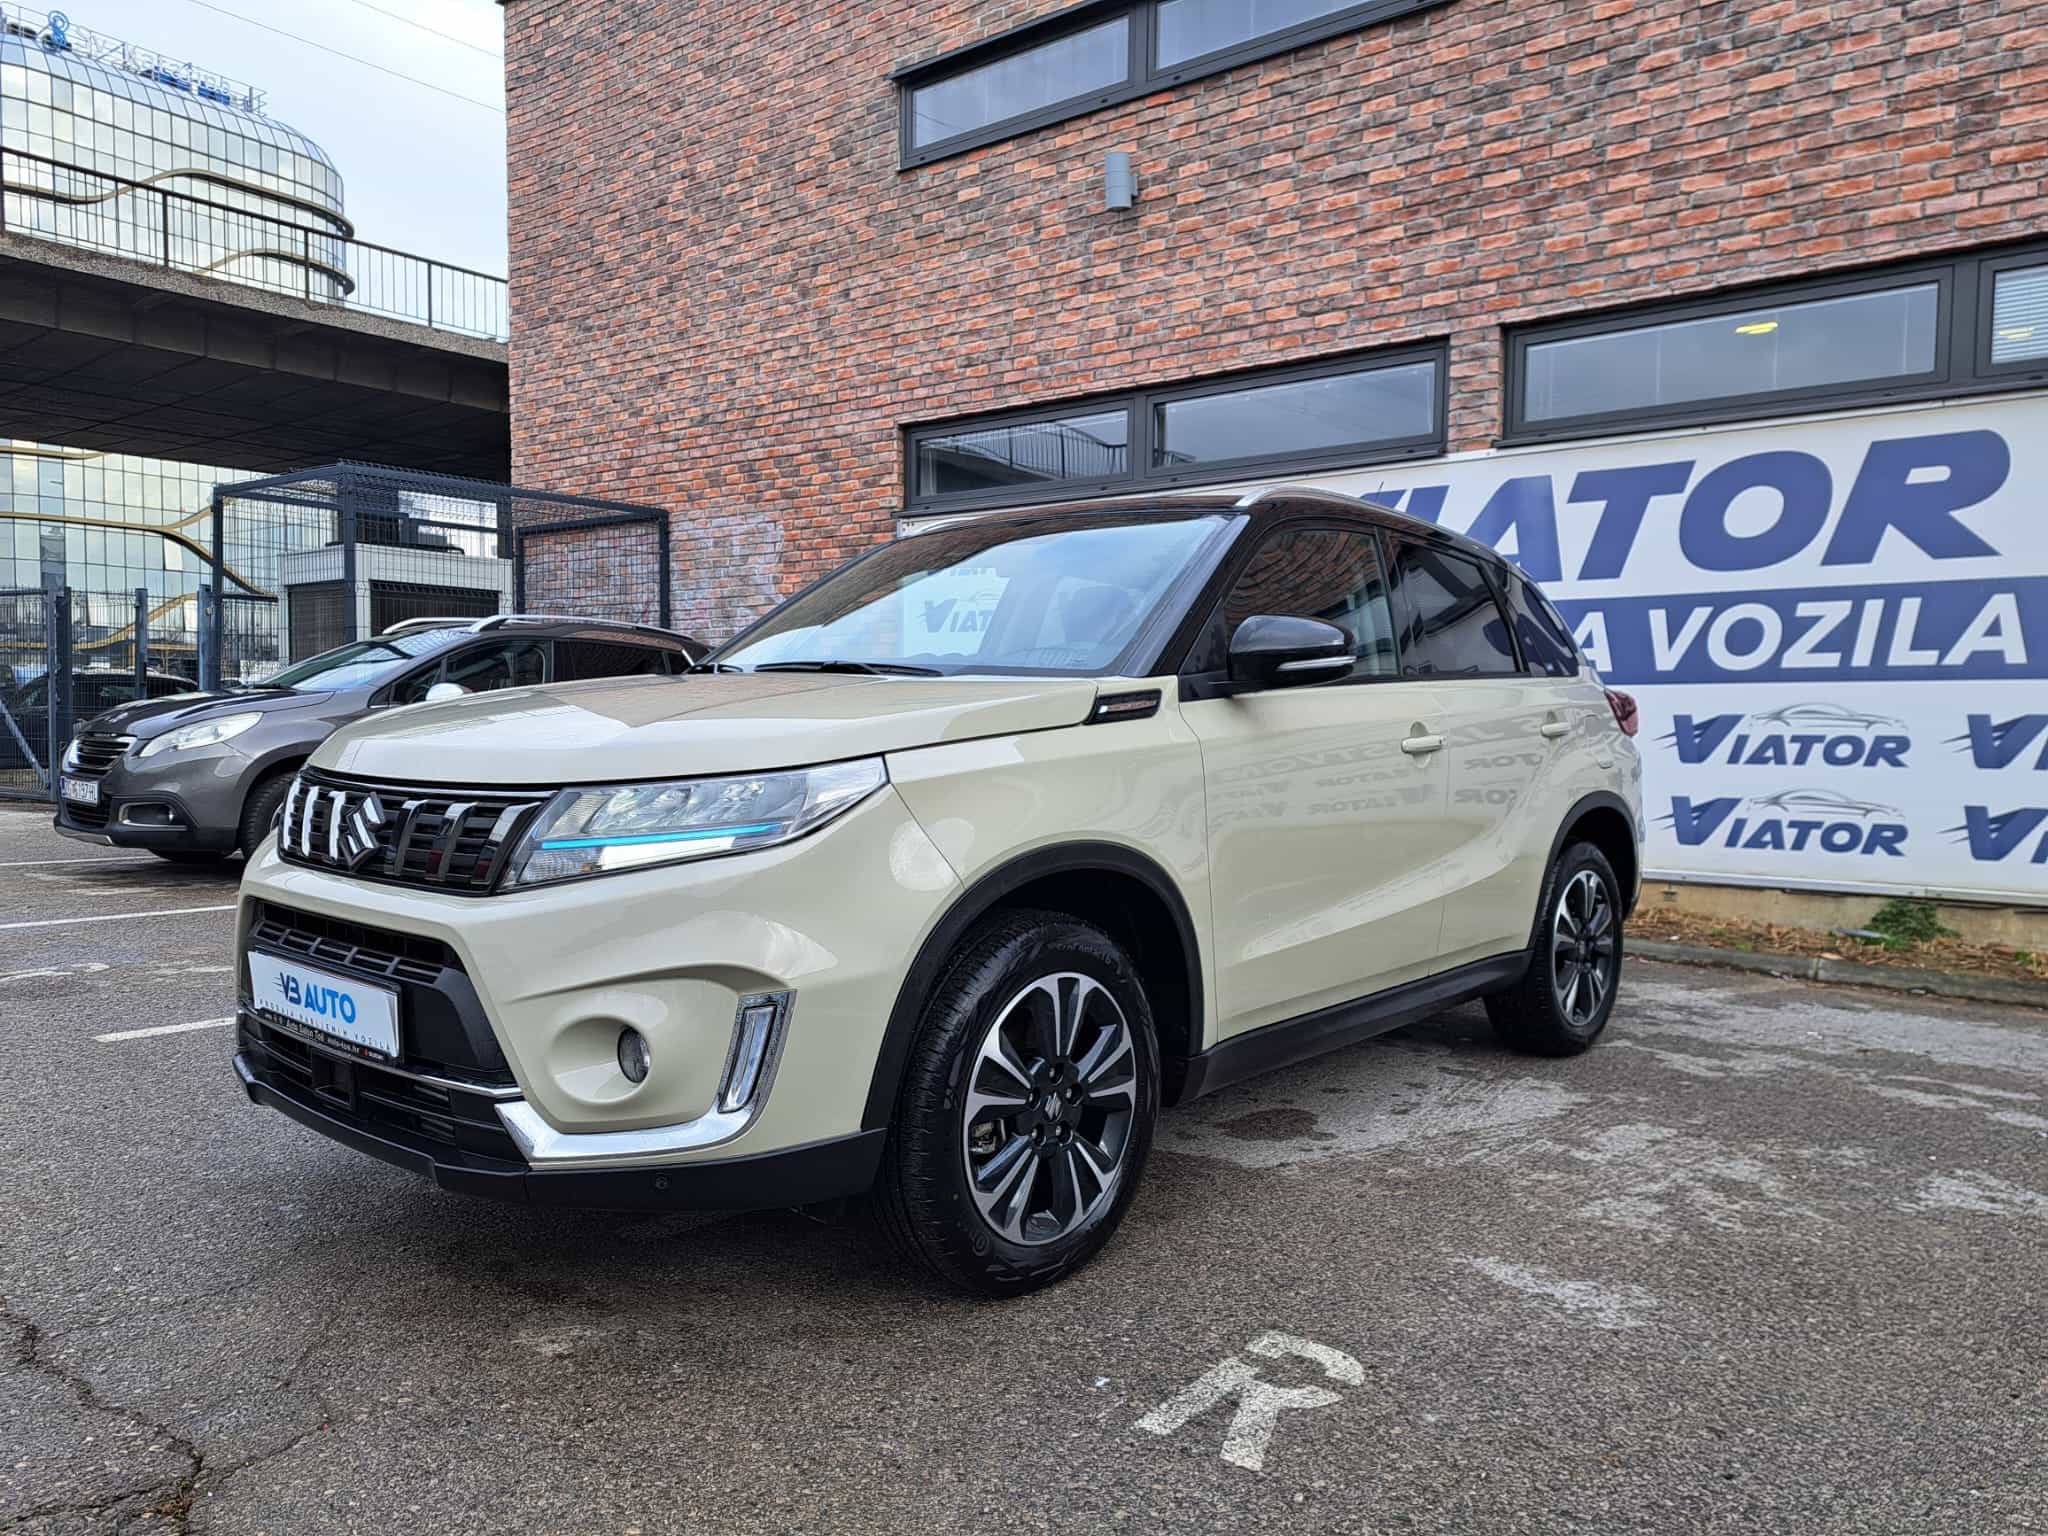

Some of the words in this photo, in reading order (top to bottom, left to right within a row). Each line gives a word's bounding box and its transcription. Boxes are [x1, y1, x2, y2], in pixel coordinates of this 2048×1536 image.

[1359, 429, 2011, 583] ATOR
[1648, 593, 2028, 672] VOZILA
[1672, 713, 1911, 768] VIATOR
[1670, 796, 1909, 857] VIATOR
[304, 981, 357, 1025] AUTO
